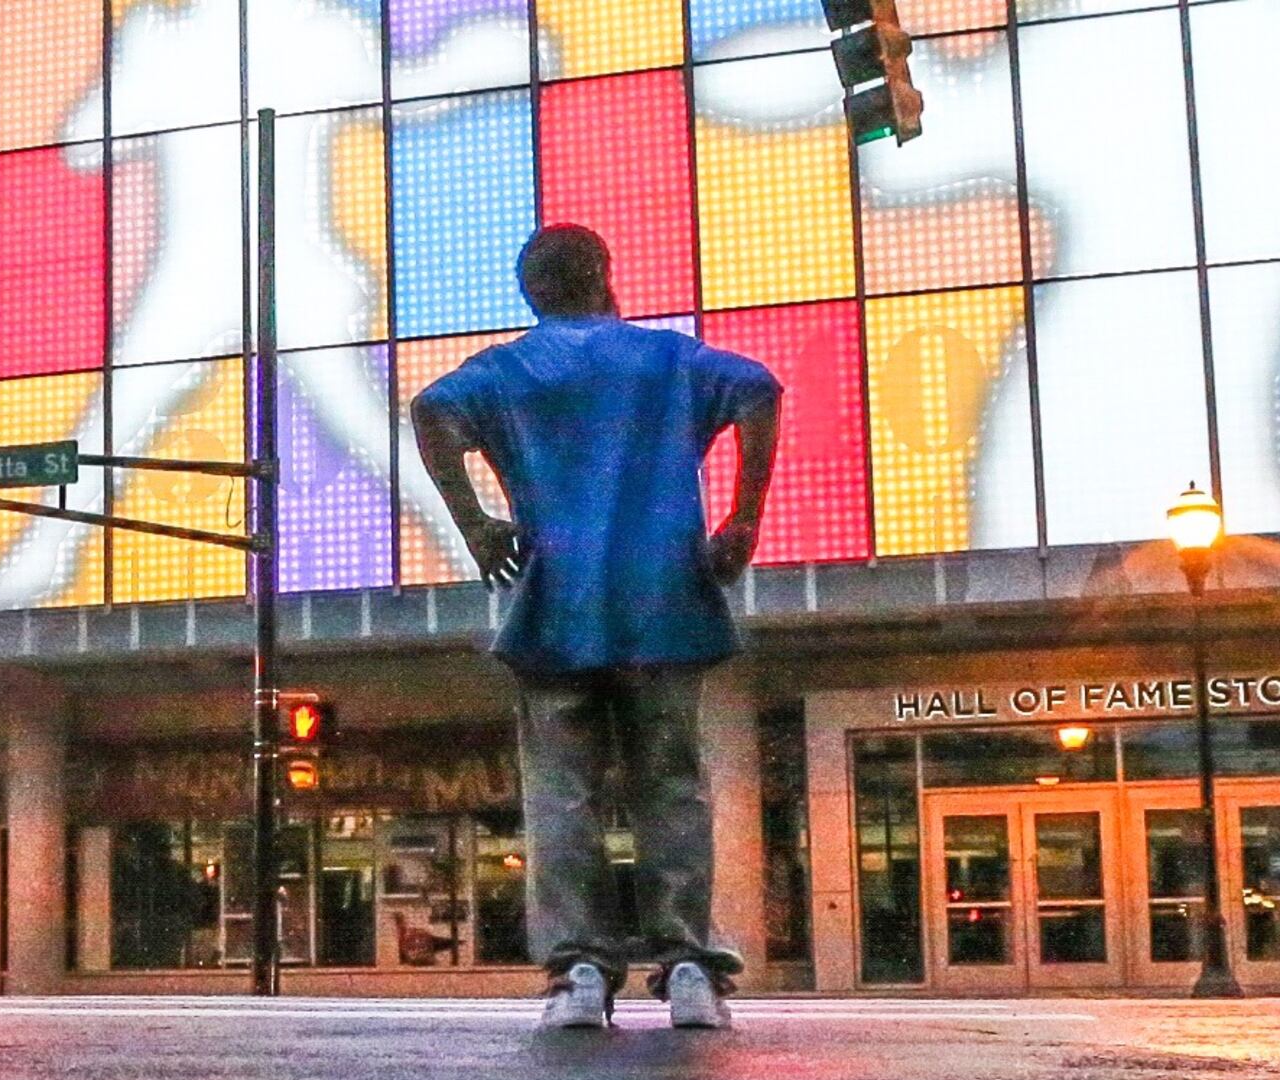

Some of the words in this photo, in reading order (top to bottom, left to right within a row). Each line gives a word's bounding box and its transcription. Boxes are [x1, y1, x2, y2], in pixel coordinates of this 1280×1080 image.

[44, 453, 70, 475] St
[894, 690, 997, 721] HALL
[1011, 685, 1066, 716] OF
[1080, 679, 1193, 713] FAME
